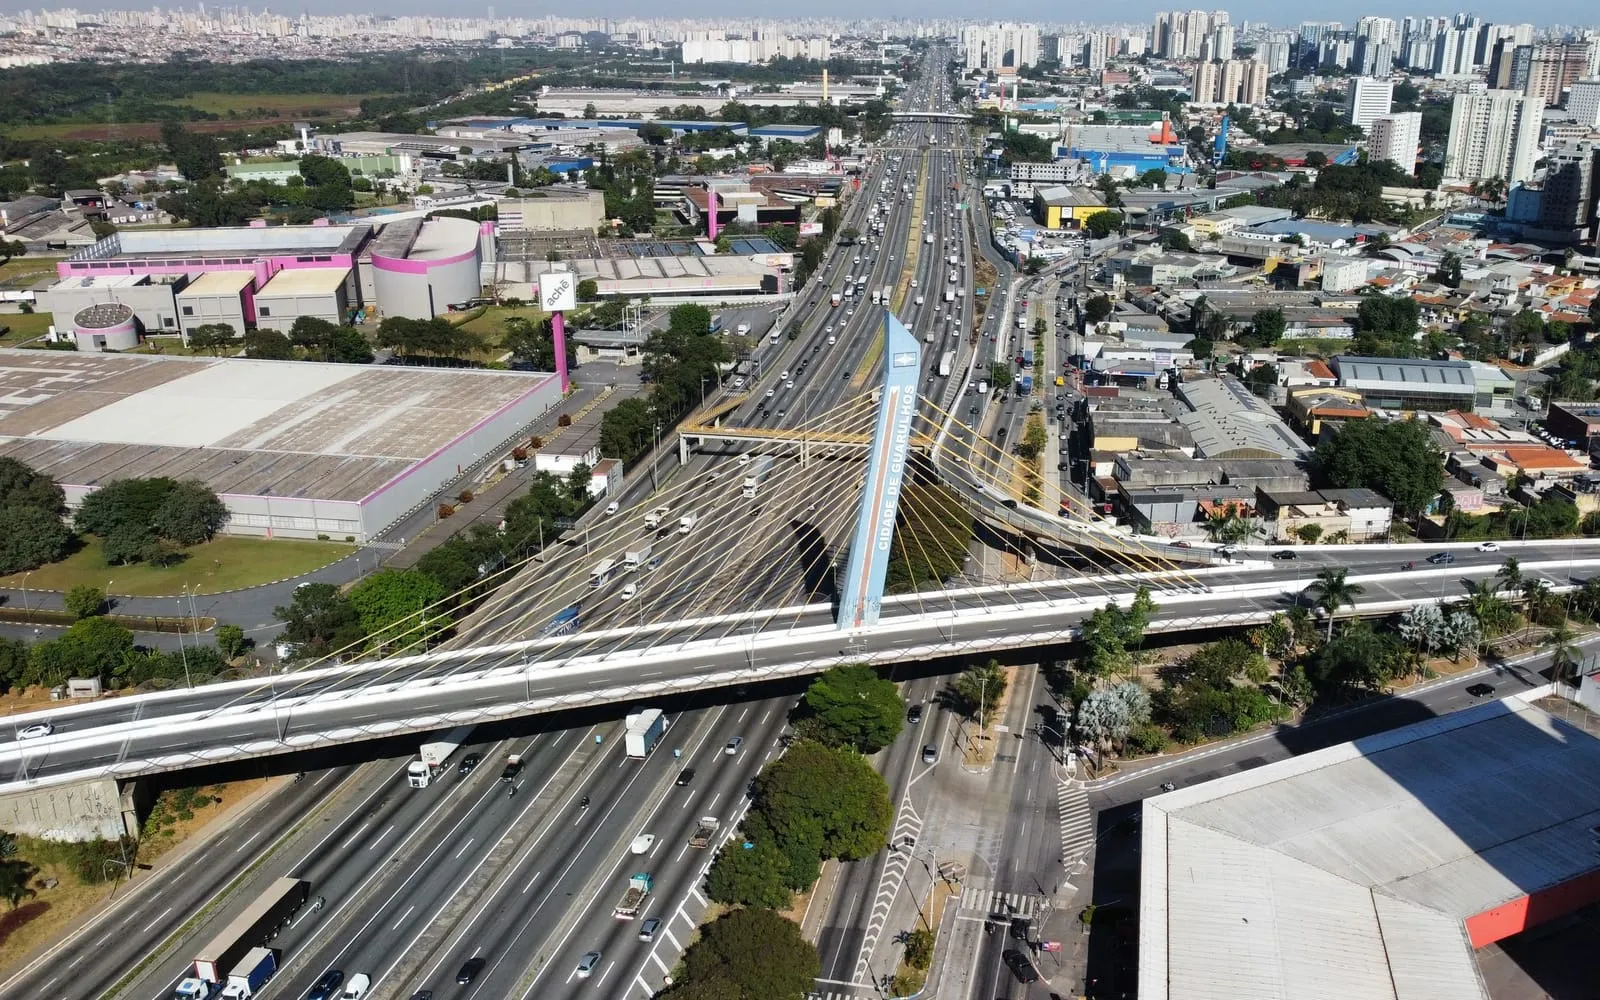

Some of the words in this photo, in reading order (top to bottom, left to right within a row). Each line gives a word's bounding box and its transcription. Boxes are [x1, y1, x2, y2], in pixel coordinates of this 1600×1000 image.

[891, 384, 915, 474] GUARULHOS
[887, 476, 900, 496] DE
[878, 499, 896, 551] CIDADE
